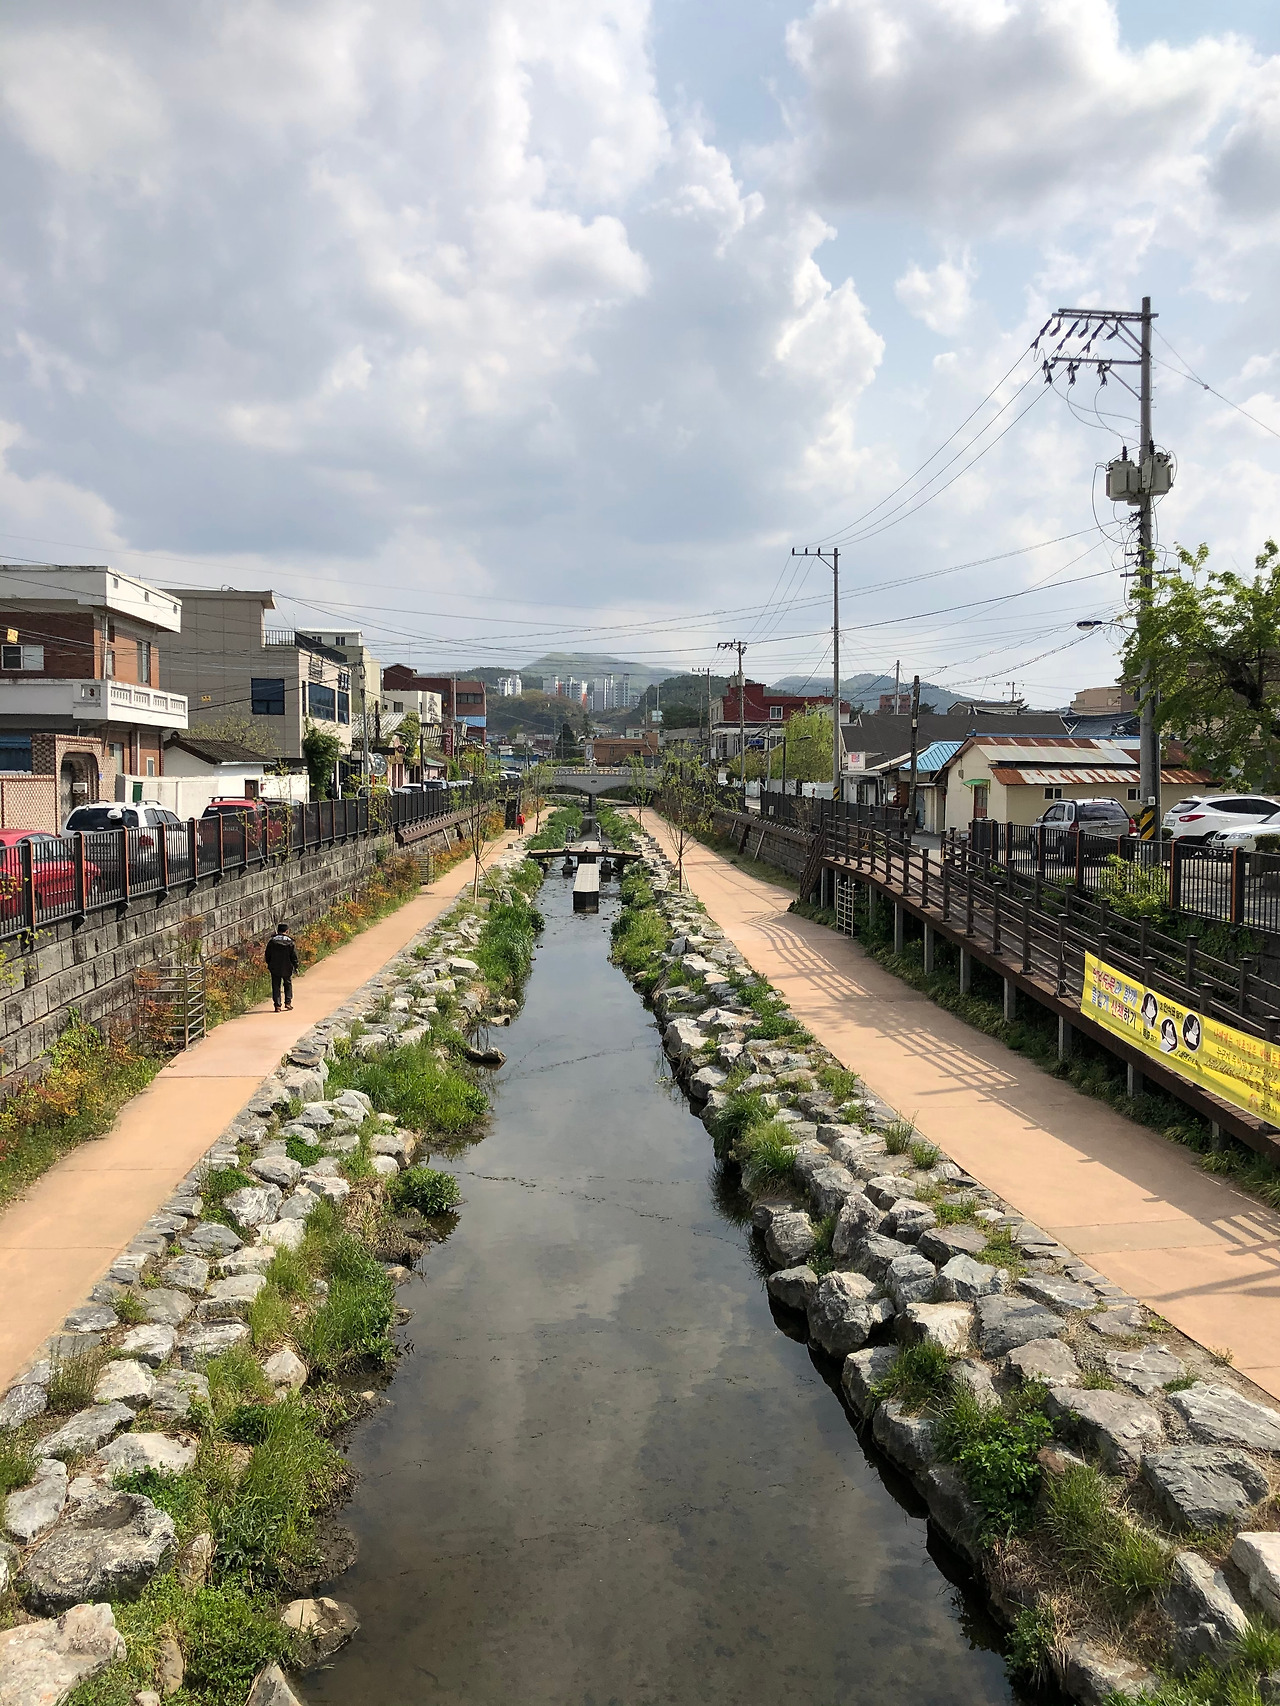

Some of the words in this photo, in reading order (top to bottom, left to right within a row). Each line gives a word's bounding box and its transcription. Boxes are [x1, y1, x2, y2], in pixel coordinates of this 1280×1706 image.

[1092, 967, 1122, 995] 반려동물과
[1123, 984, 1138, 1008] 함께
[1091, 986, 1110, 1013] 즐겁게
[1111, 999, 1137, 1030] 산책하기
[1260, 1047, 1280, 1069] 반려동
[1260, 1099, 1278, 1117] 공주시
